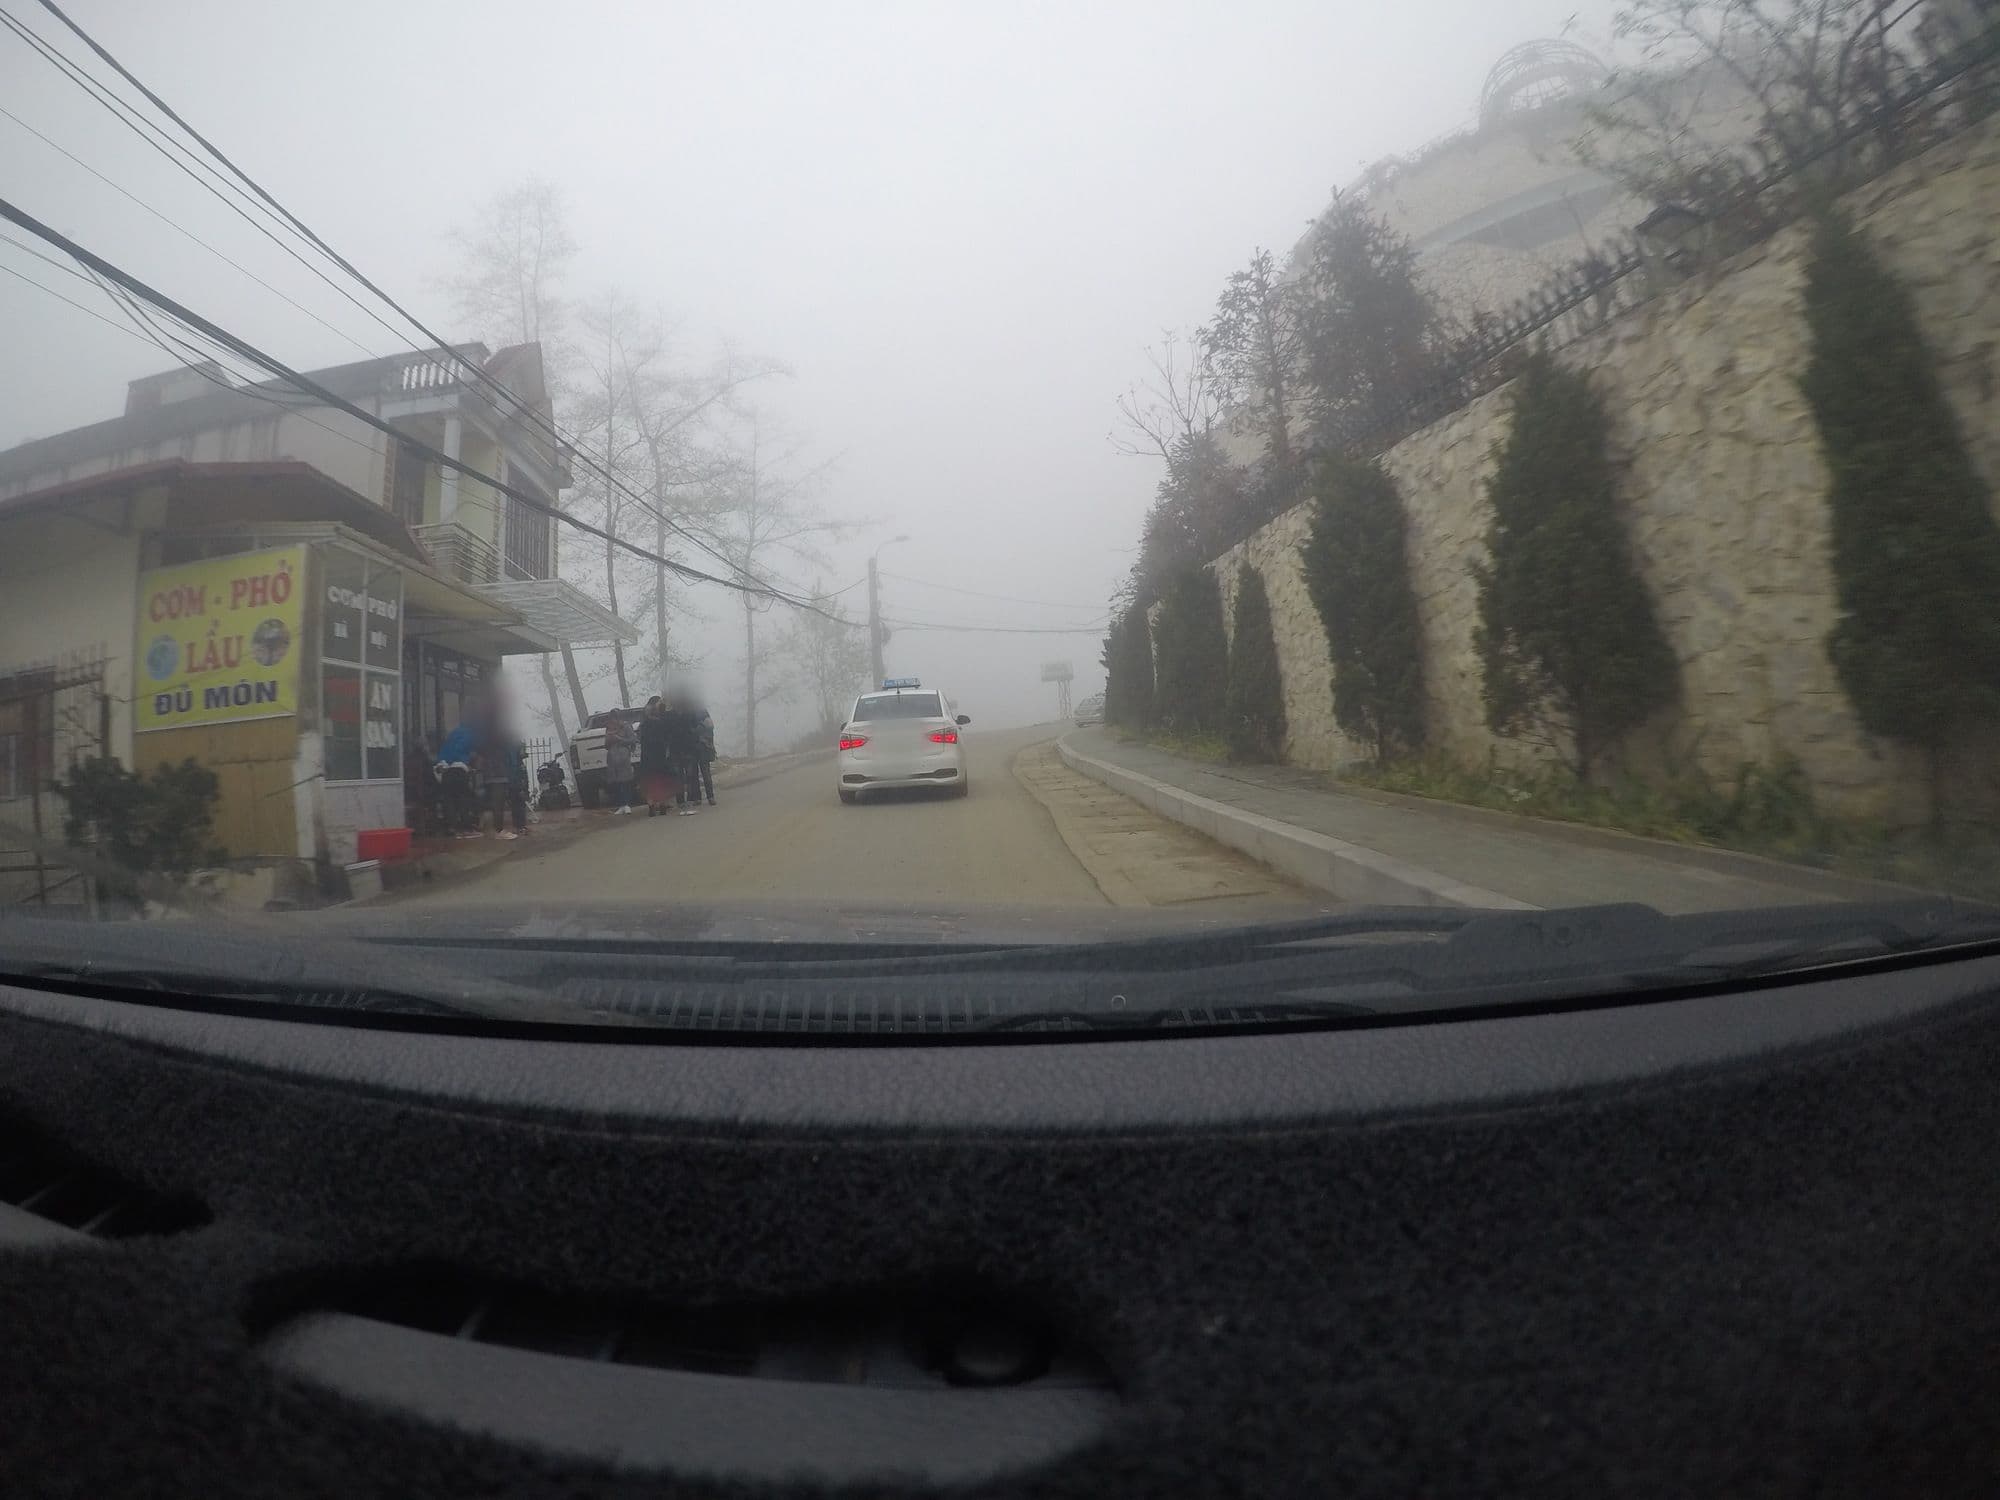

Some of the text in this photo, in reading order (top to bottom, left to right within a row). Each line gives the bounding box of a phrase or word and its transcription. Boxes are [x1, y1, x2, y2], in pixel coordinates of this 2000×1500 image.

[150, 582, 207, 622] CƠM
[230, 559, 293, 610] PHỞ
[185, 619, 244, 674] LẨU
[204, 679, 278, 709] MÓN
